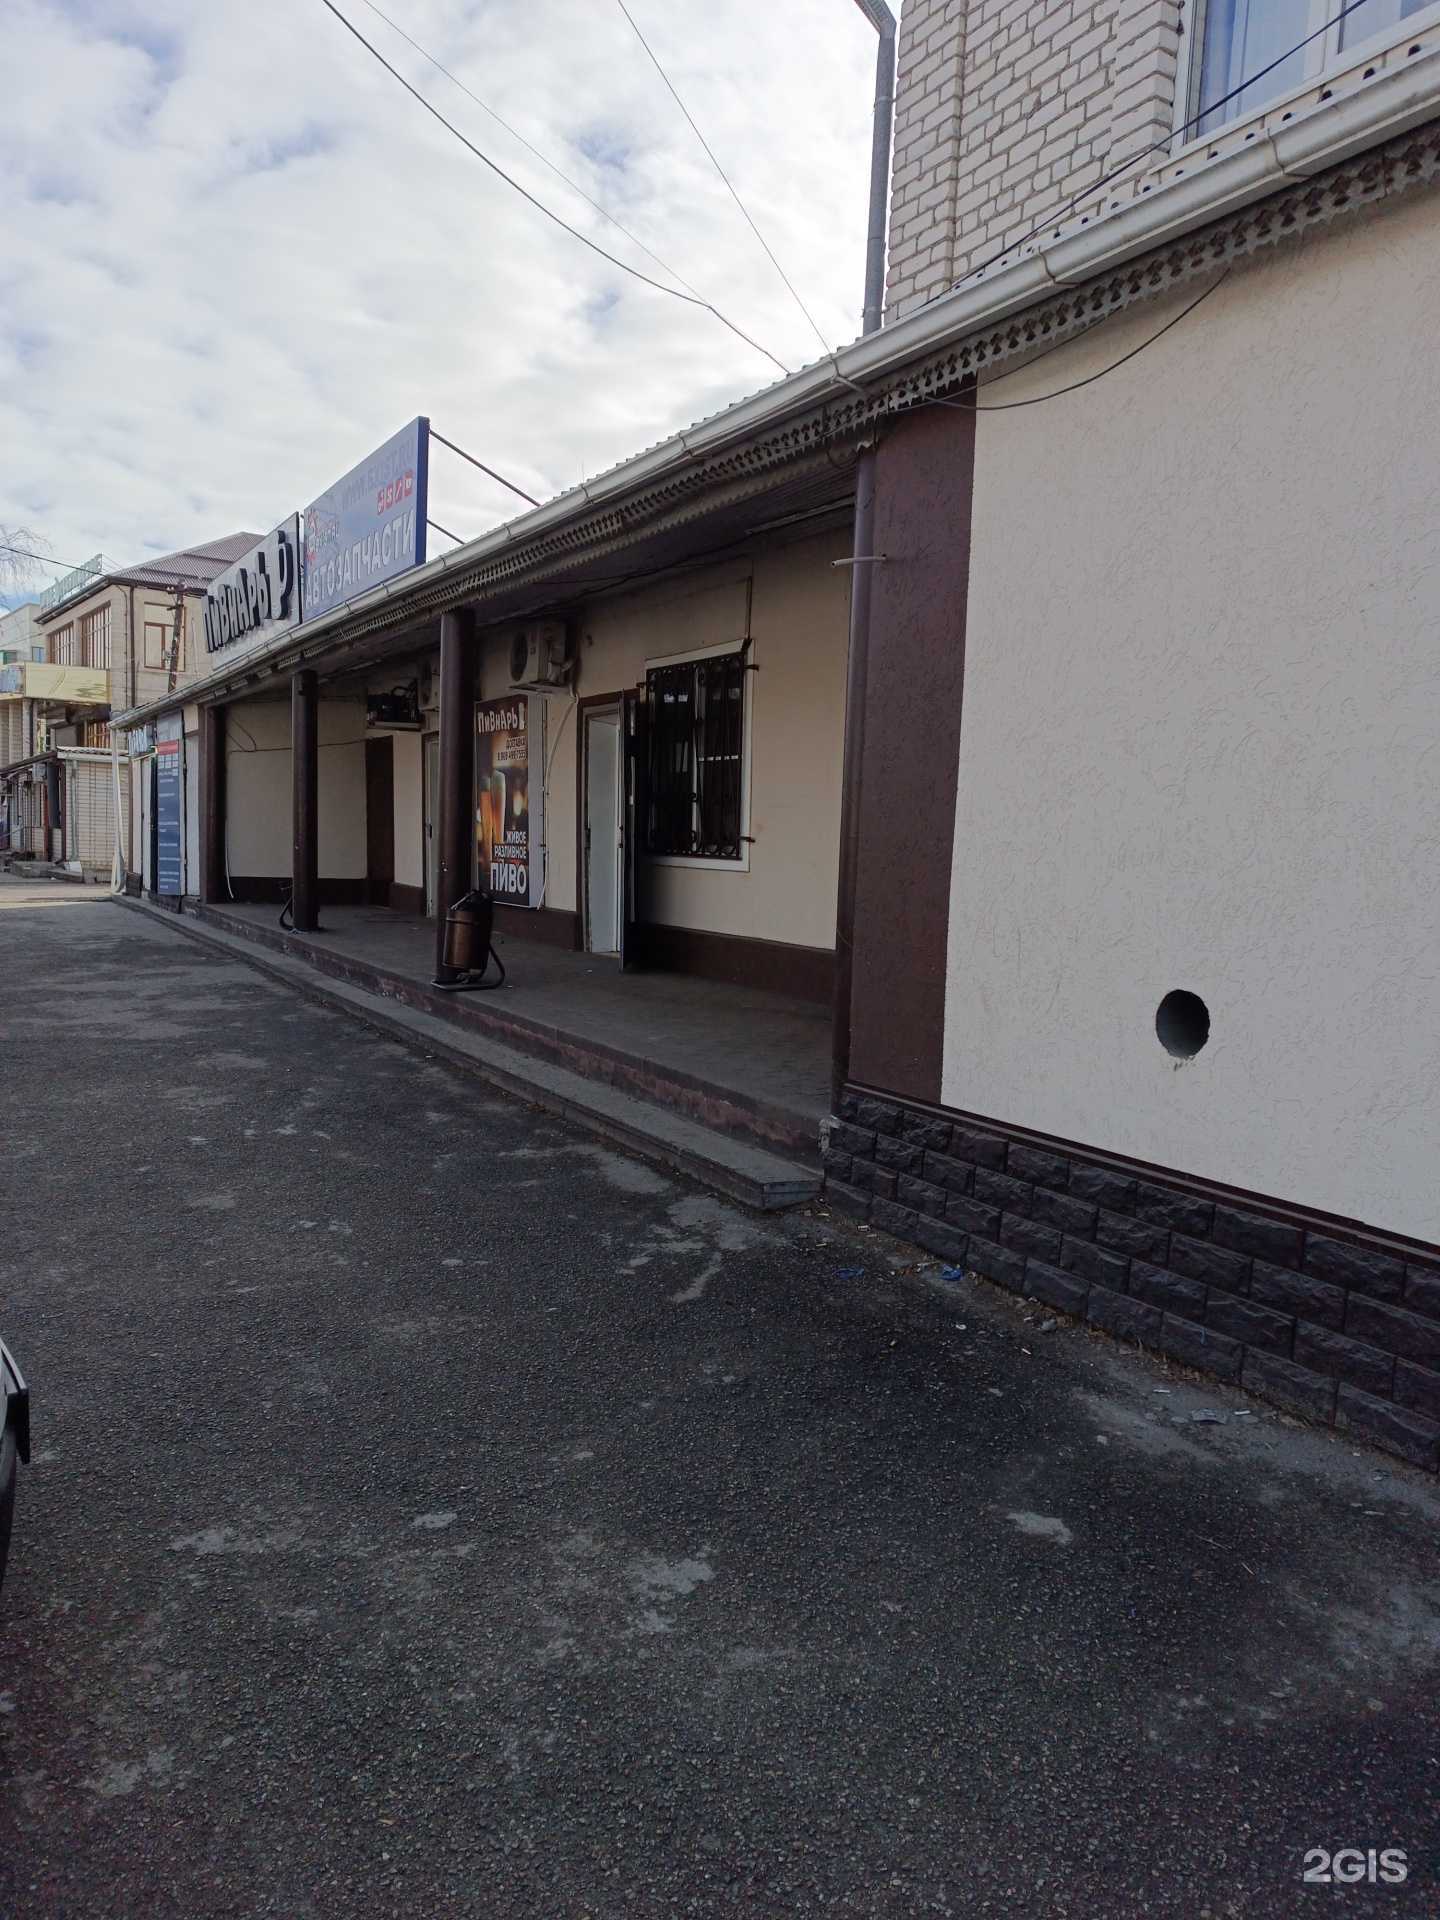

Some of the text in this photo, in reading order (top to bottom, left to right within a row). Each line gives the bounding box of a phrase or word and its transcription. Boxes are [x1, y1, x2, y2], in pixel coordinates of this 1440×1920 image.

[305, 510, 414, 607] АВТОЗАПЧАСТИ
[506, 831, 527, 844] ЖИВОЕ
[494, 845, 527, 859] РАЗЛИВНОЕ
[490, 862, 527, 894] ПИВО
